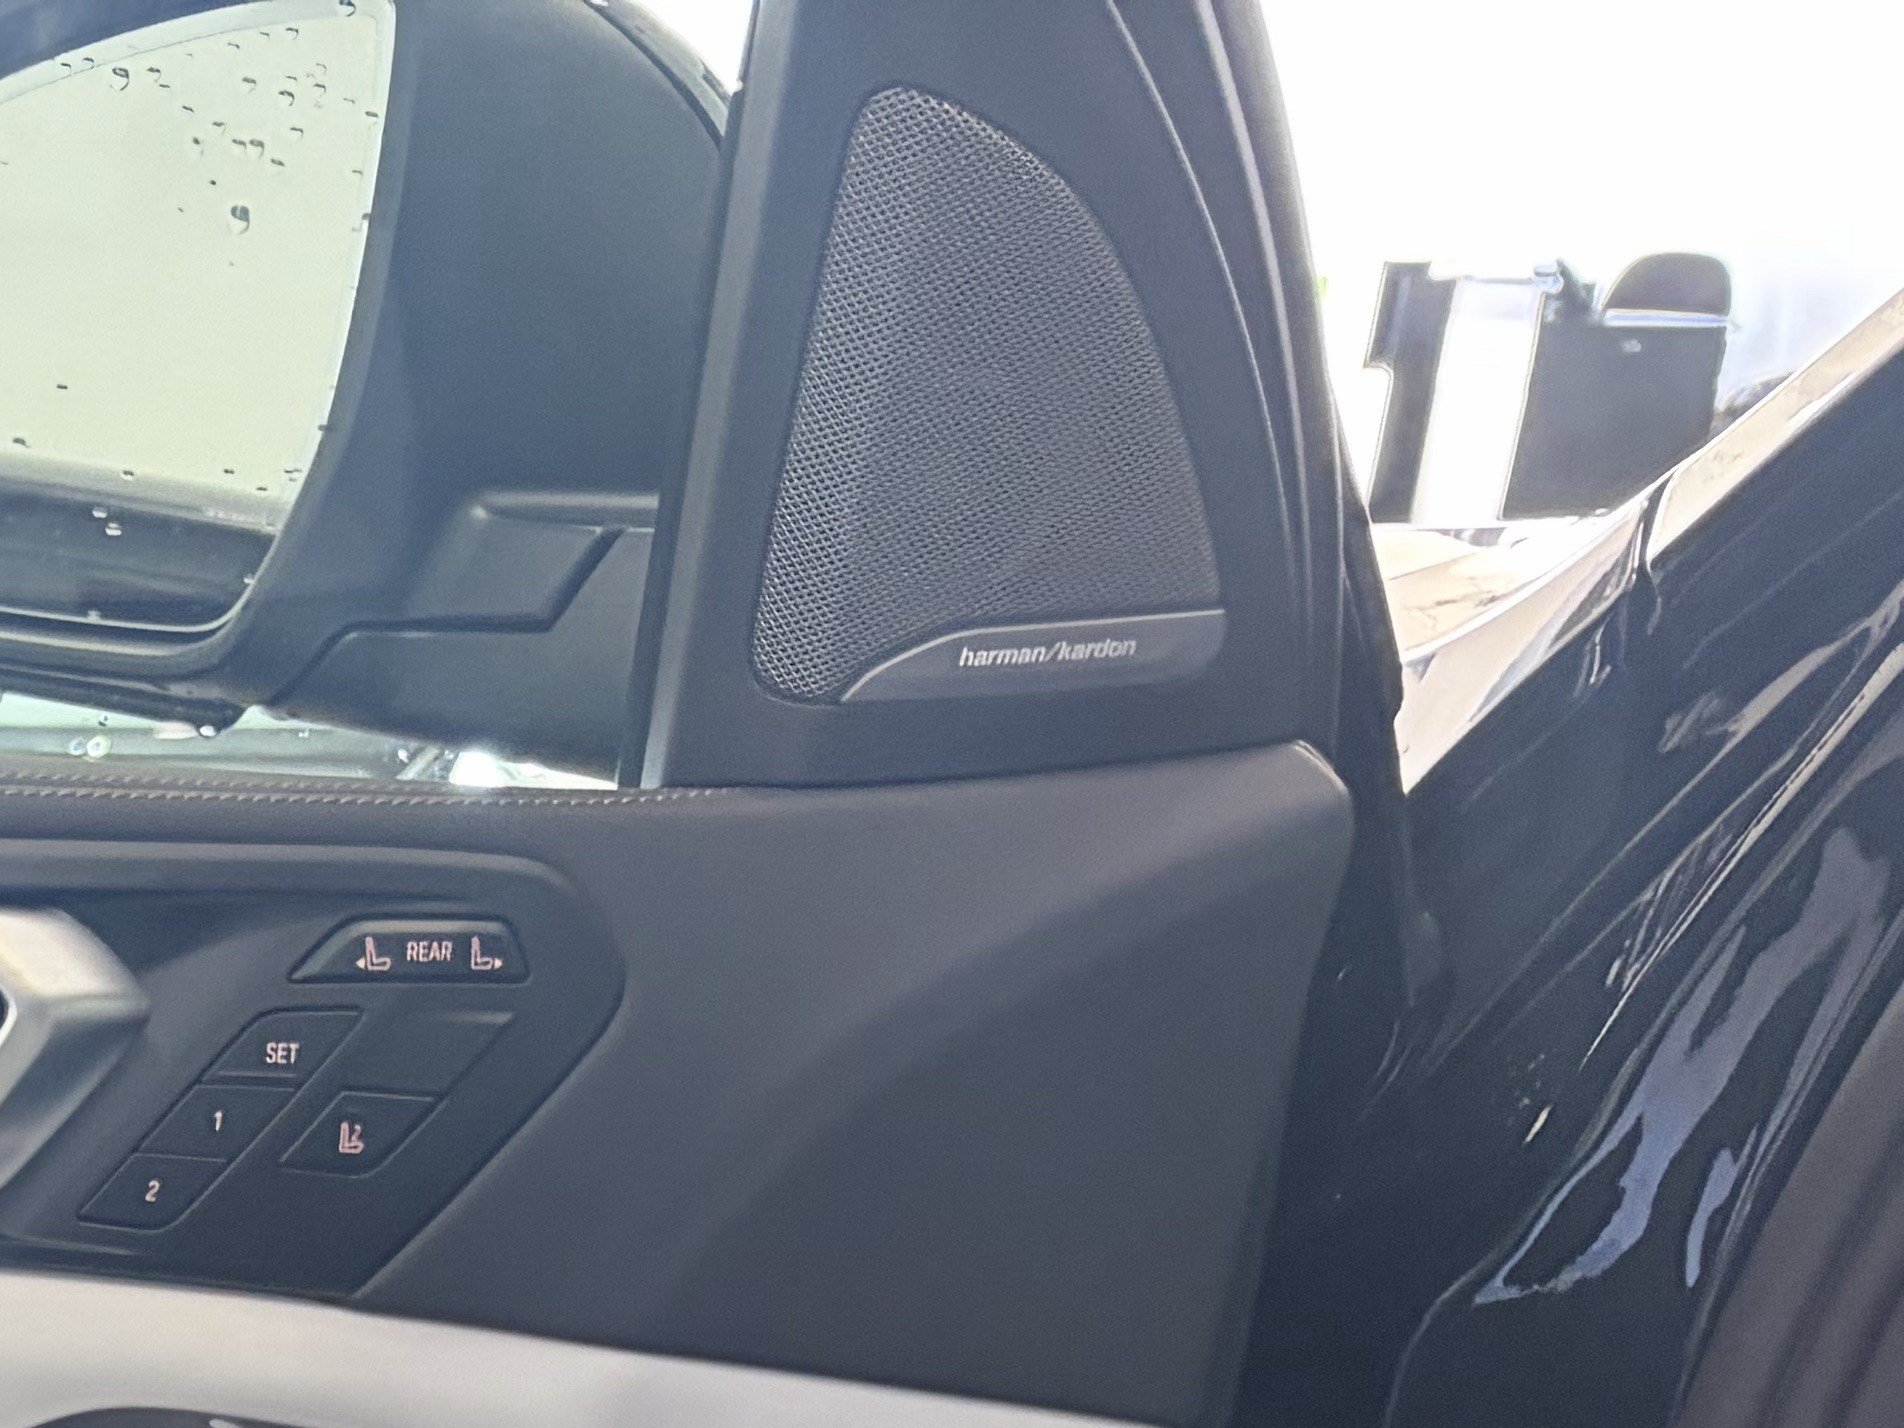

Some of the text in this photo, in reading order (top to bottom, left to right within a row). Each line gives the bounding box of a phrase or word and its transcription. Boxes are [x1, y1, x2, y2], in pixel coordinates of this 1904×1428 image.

[959, 638, 1137, 667] harman/kardon
[406, 941, 453, 962] REAR
[265, 1042, 300, 1064] SET
[214, 1110, 223, 1132] 1
[145, 1180, 160, 1202] 2
